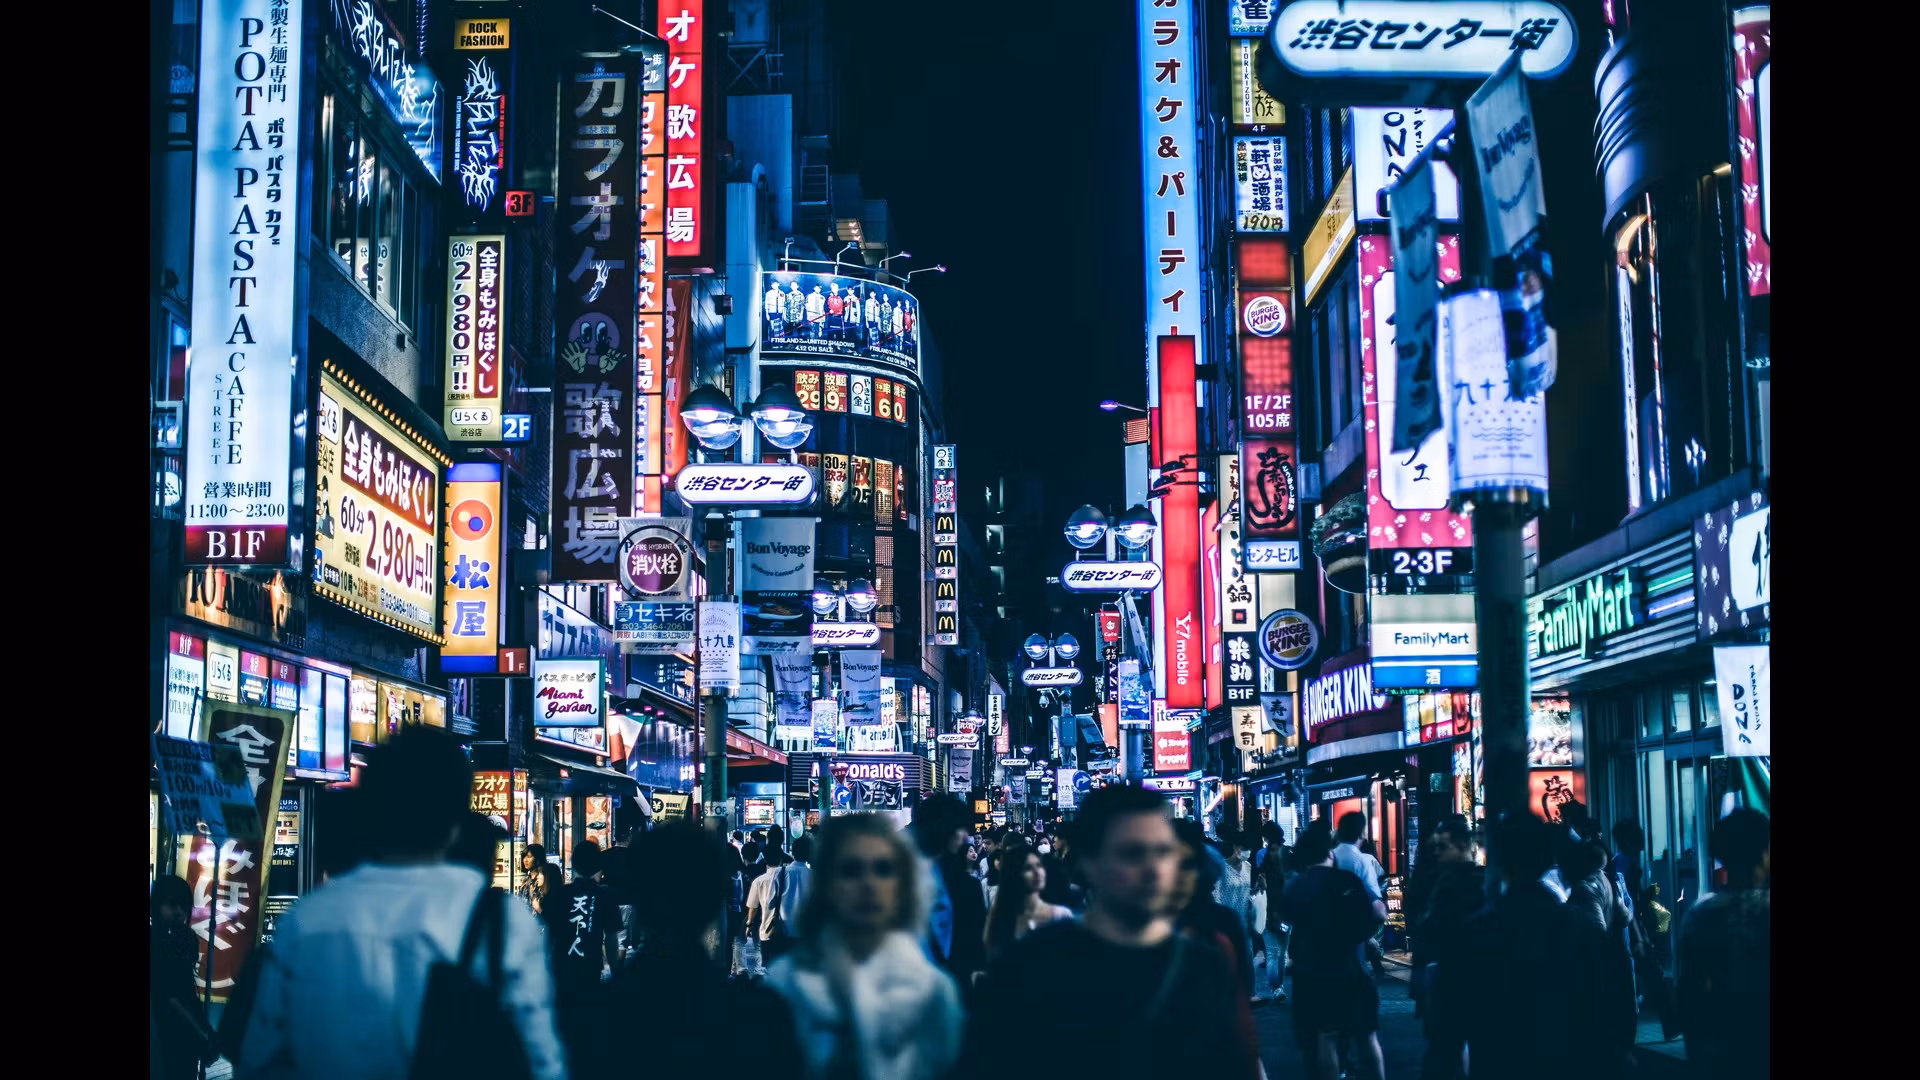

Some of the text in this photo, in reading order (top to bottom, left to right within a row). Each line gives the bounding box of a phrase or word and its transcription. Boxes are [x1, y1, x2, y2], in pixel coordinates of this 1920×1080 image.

[468, 22, 498, 34] ROCK
[1288, 18, 1560, 50] 渋谷センター街
[460, 35, 505, 46] FASHION
[666, 9, 697, 243] オケ歌広場
[568, 60, 627, 305] カラオケ
[1250, 140, 1272, 212] 一軒め酒場
[510, 194, 533, 213] 3F
[1243, 215, 1283, 231] 190円
[226, 17, 266, 465] POTA PASTA CAFFE
[452, 243, 473, 258] 60分
[1250, 304, 1278, 317] BURGER
[477, 246, 499, 393] 全身もみほぐし
[1252, 311, 1280, 328] KING
[796, 373, 819, 385] 飲み
[1244, 395, 1291, 410] 1F/2F
[211, 373, 223, 465] STREET
[454, 410, 489, 422] りらくる
[1247, 413, 1290, 428] 105席
[460, 428, 483, 437] 渋谷店
[503, 418, 530, 438] 2F
[824, 456, 847, 469] 30分
[343, 420, 435, 526] 全身もみほぐし
[563, 382, 622, 565] 歌広場
[824, 470, 848, 482] 飲み
[203, 481, 272, 498] 営業時間
[684, 475, 807, 492] 渋谷センター街
[341, 495, 365, 535] 60分
[206, 530, 266, 558] B1F
[746, 541, 811, 557] Bon Voyage
[1246, 548, 1298, 562] センタービル
[631, 553, 679, 576] 消火栓
[1069, 569, 1156, 581] 渋谷センター街
[450, 554, 491, 636] 松屋
[635, 604, 694, 622] セキネ
[1534, 566, 1635, 661] FamilyMart
[1267, 622, 1309, 641] BURGER
[1394, 632, 1469, 647] FamilyMart
[1175, 611, 1192, 686] Y!mobile
[1269, 631, 1311, 653] KING
[843, 662, 880, 672] Bon Voyage
[1227, 636, 1252, 681] 米助
[775, 664, 811, 673] Bon Voyage
[1024, 672, 1078, 681] 渋谷センター街
[1425, 668, 1441, 684] 酒
[536, 687, 585, 700] Miami
[1228, 689, 1253, 699] B1F
[1309, 674, 1343, 726] BURGER
[1269, 698, 1287, 733] 寿司
[1240, 712, 1256, 746] 寿司
[567, 895, 588, 957] 天下人
